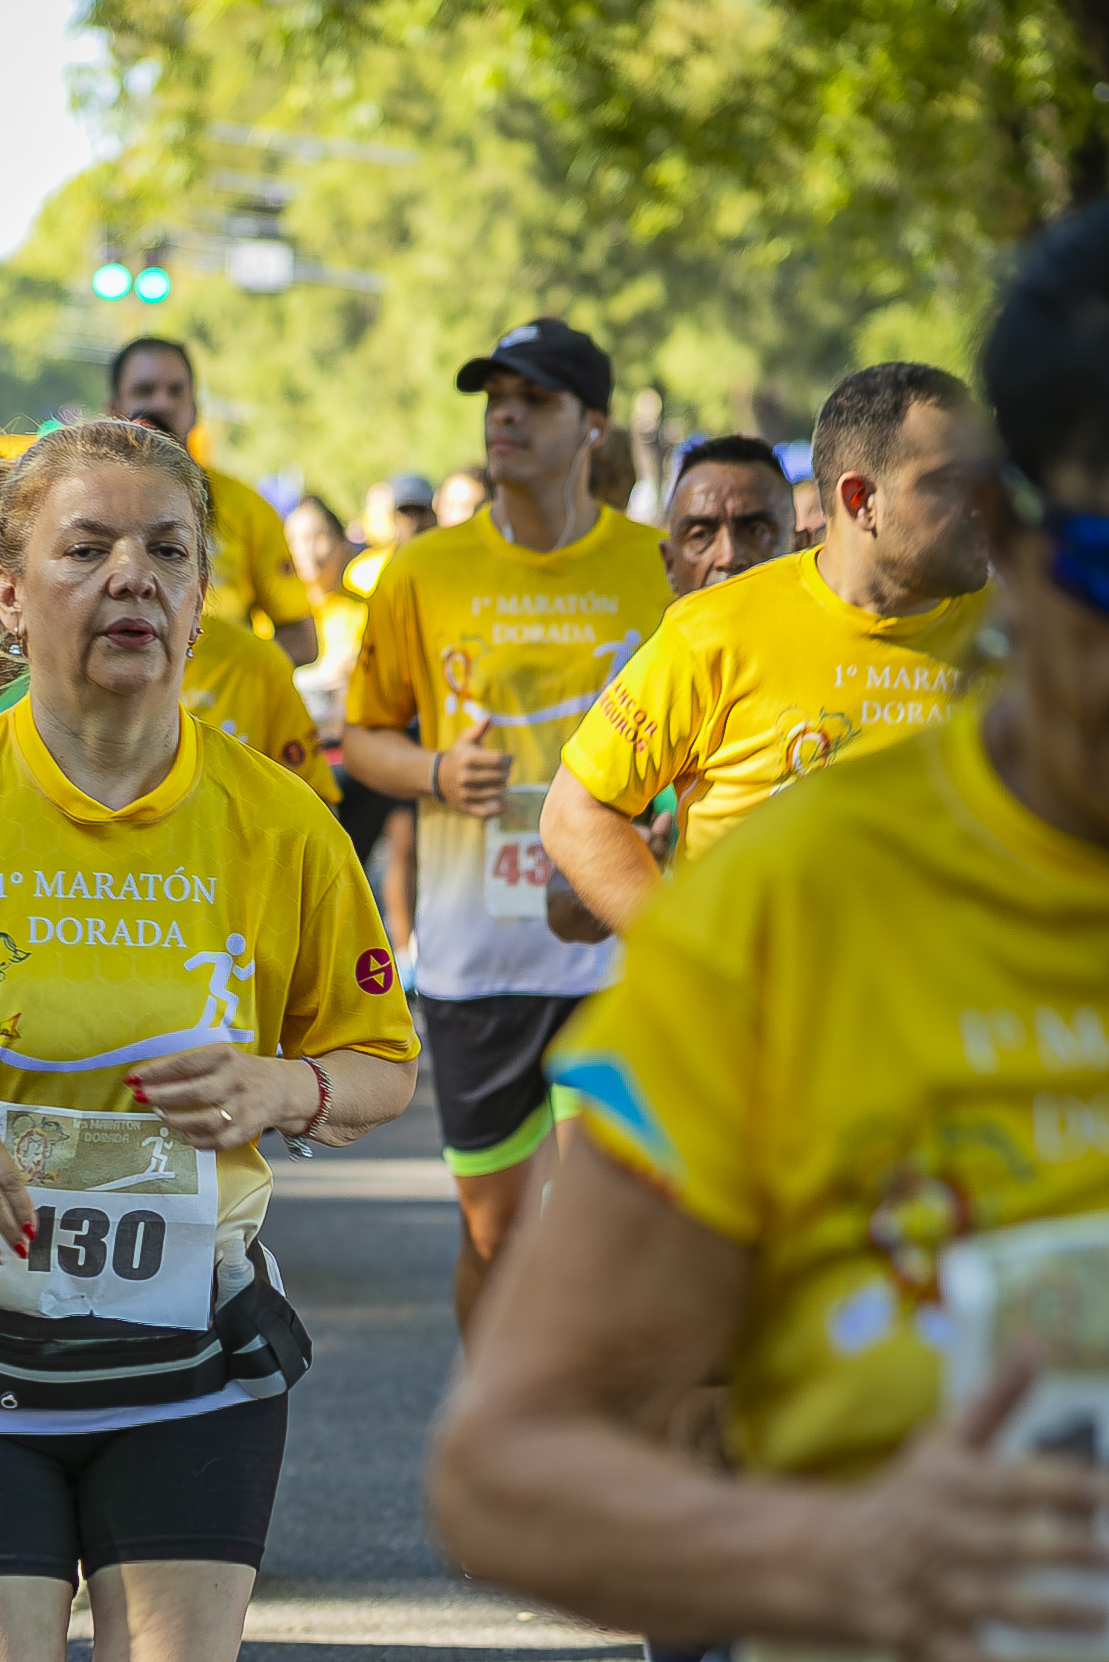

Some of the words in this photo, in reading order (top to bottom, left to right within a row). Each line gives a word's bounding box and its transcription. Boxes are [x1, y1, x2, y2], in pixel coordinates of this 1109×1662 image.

[496, 590, 618, 616] MARATÓN
[493, 622, 596, 645] DORADA
[865, 664, 970, 693] MARAT
[860, 699, 952, 726] DORA
[33, 866, 217, 905] MARATÓN
[28, 916, 188, 948] DORADA
[27, 1205, 167, 1281] 130
